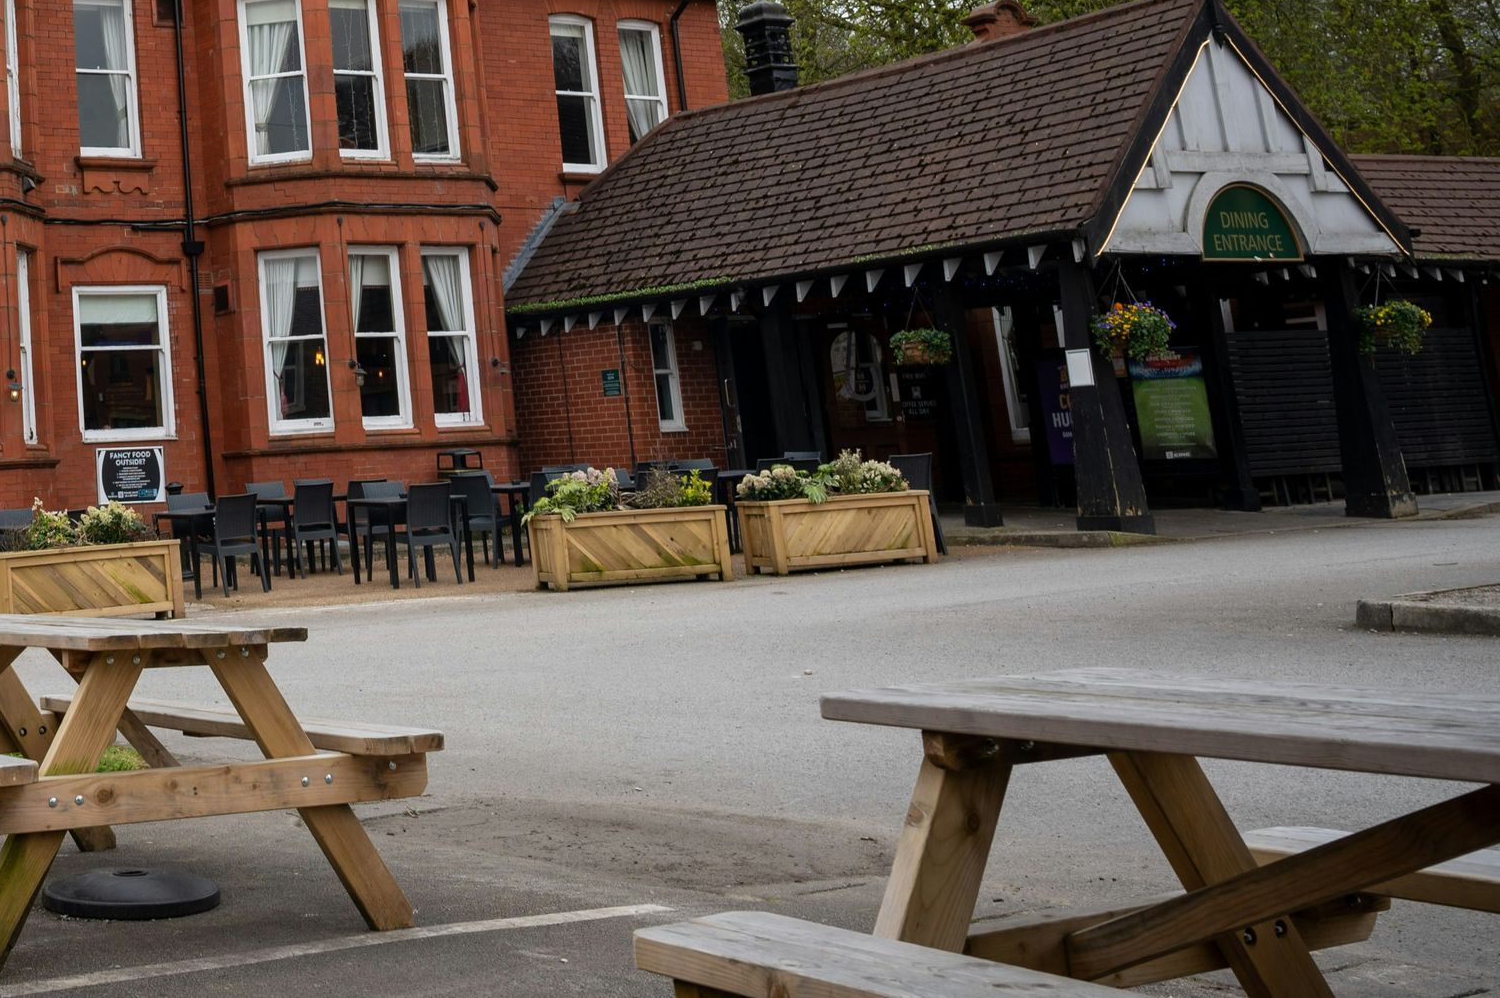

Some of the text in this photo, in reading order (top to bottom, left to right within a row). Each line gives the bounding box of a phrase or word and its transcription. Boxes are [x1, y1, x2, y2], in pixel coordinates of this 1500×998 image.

[1220, 211, 1269, 229] DINING
[1213, 233, 1284, 251] ENTRANCE
[115, 458, 146, 466] OUTSIDE?
